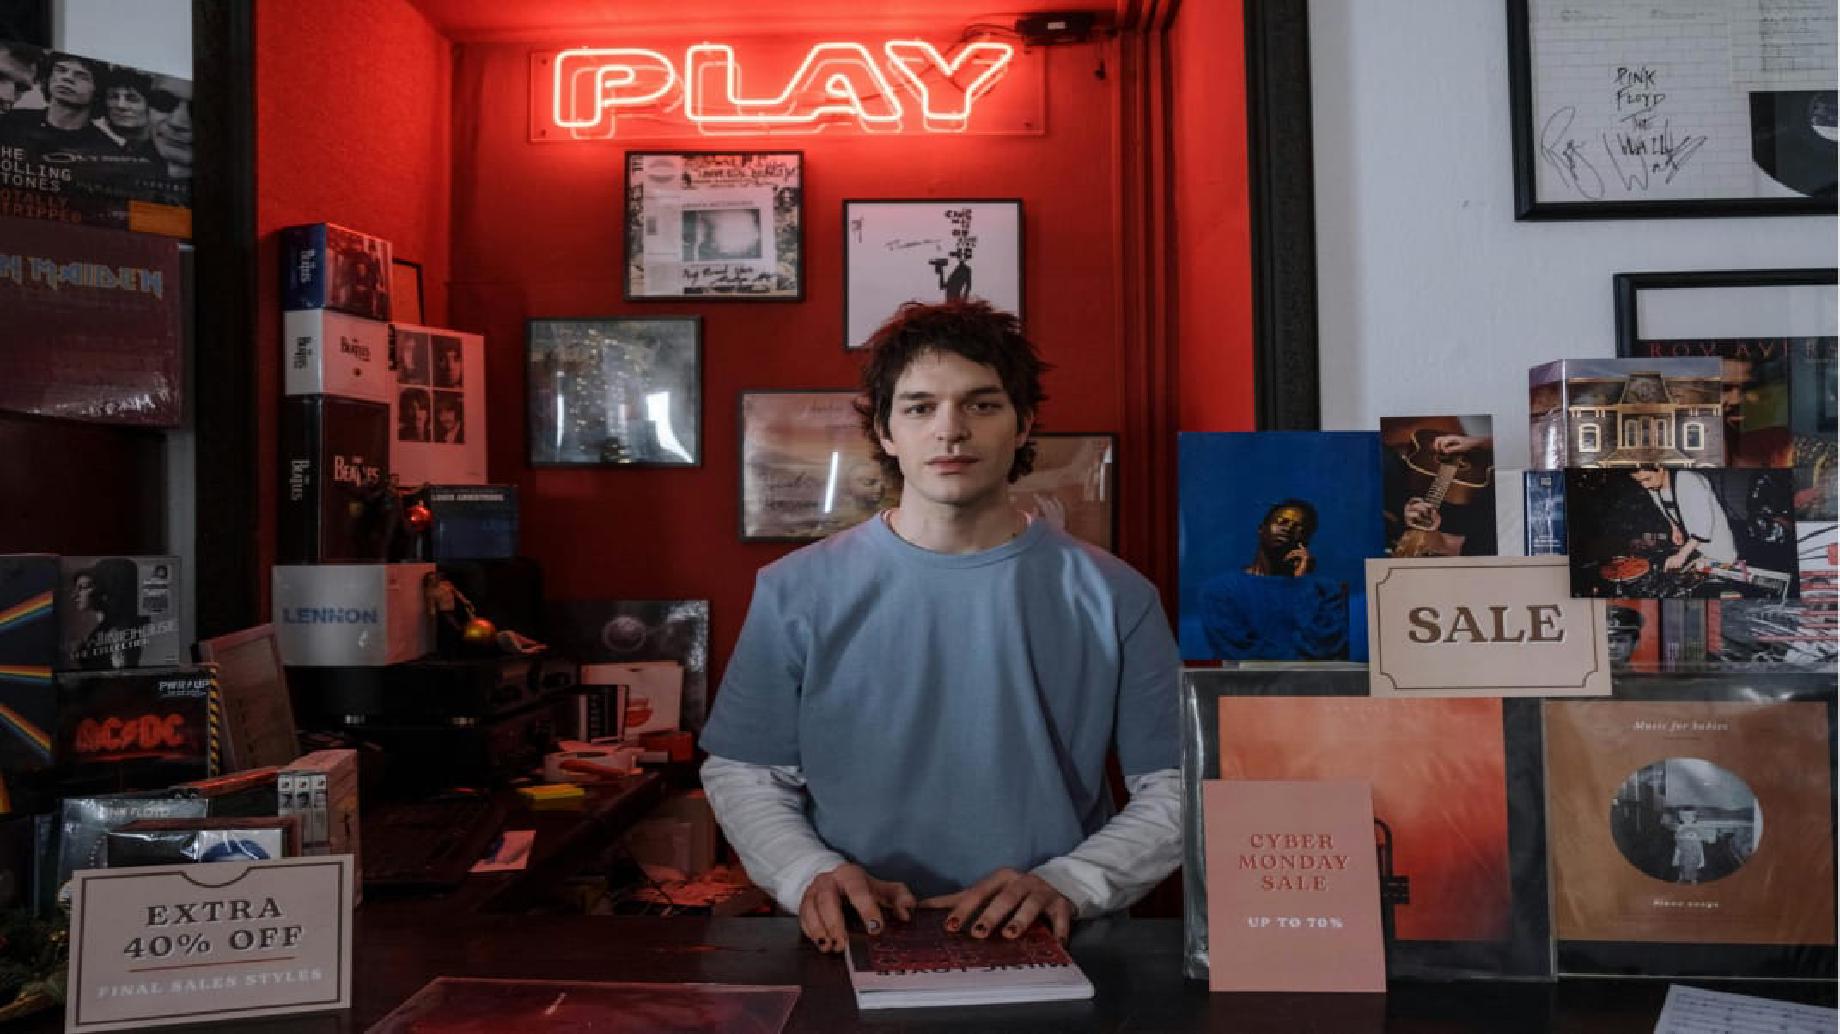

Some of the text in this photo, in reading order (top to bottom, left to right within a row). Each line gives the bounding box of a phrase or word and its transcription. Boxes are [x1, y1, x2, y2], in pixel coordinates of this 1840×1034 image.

[553, 41, 1014, 128] PLAY
[1615, 66, 1656, 89] PINK
[1616, 86, 1666, 111] FLOYD
[1649, 340, 1716, 357] ROY
[283, 607, 379, 625] LENNON
[1407, 604, 1565, 645] SALE
[77, 714, 185, 749] AC/DC
[1633, 719, 1667, 731] Music
[1669, 719, 1690, 733] for
[1249, 833, 1334, 849] CYBER
[1238, 854, 1349, 870] MONDAY
[1261, 875, 1328, 892] SALE
[147, 897, 283, 927] EXTRA
[1248, 917, 1344, 929] UP TO 70%
[123, 925, 302, 960] 40% OFF
[96, 968, 323, 999] FINAL SALES STYLES
